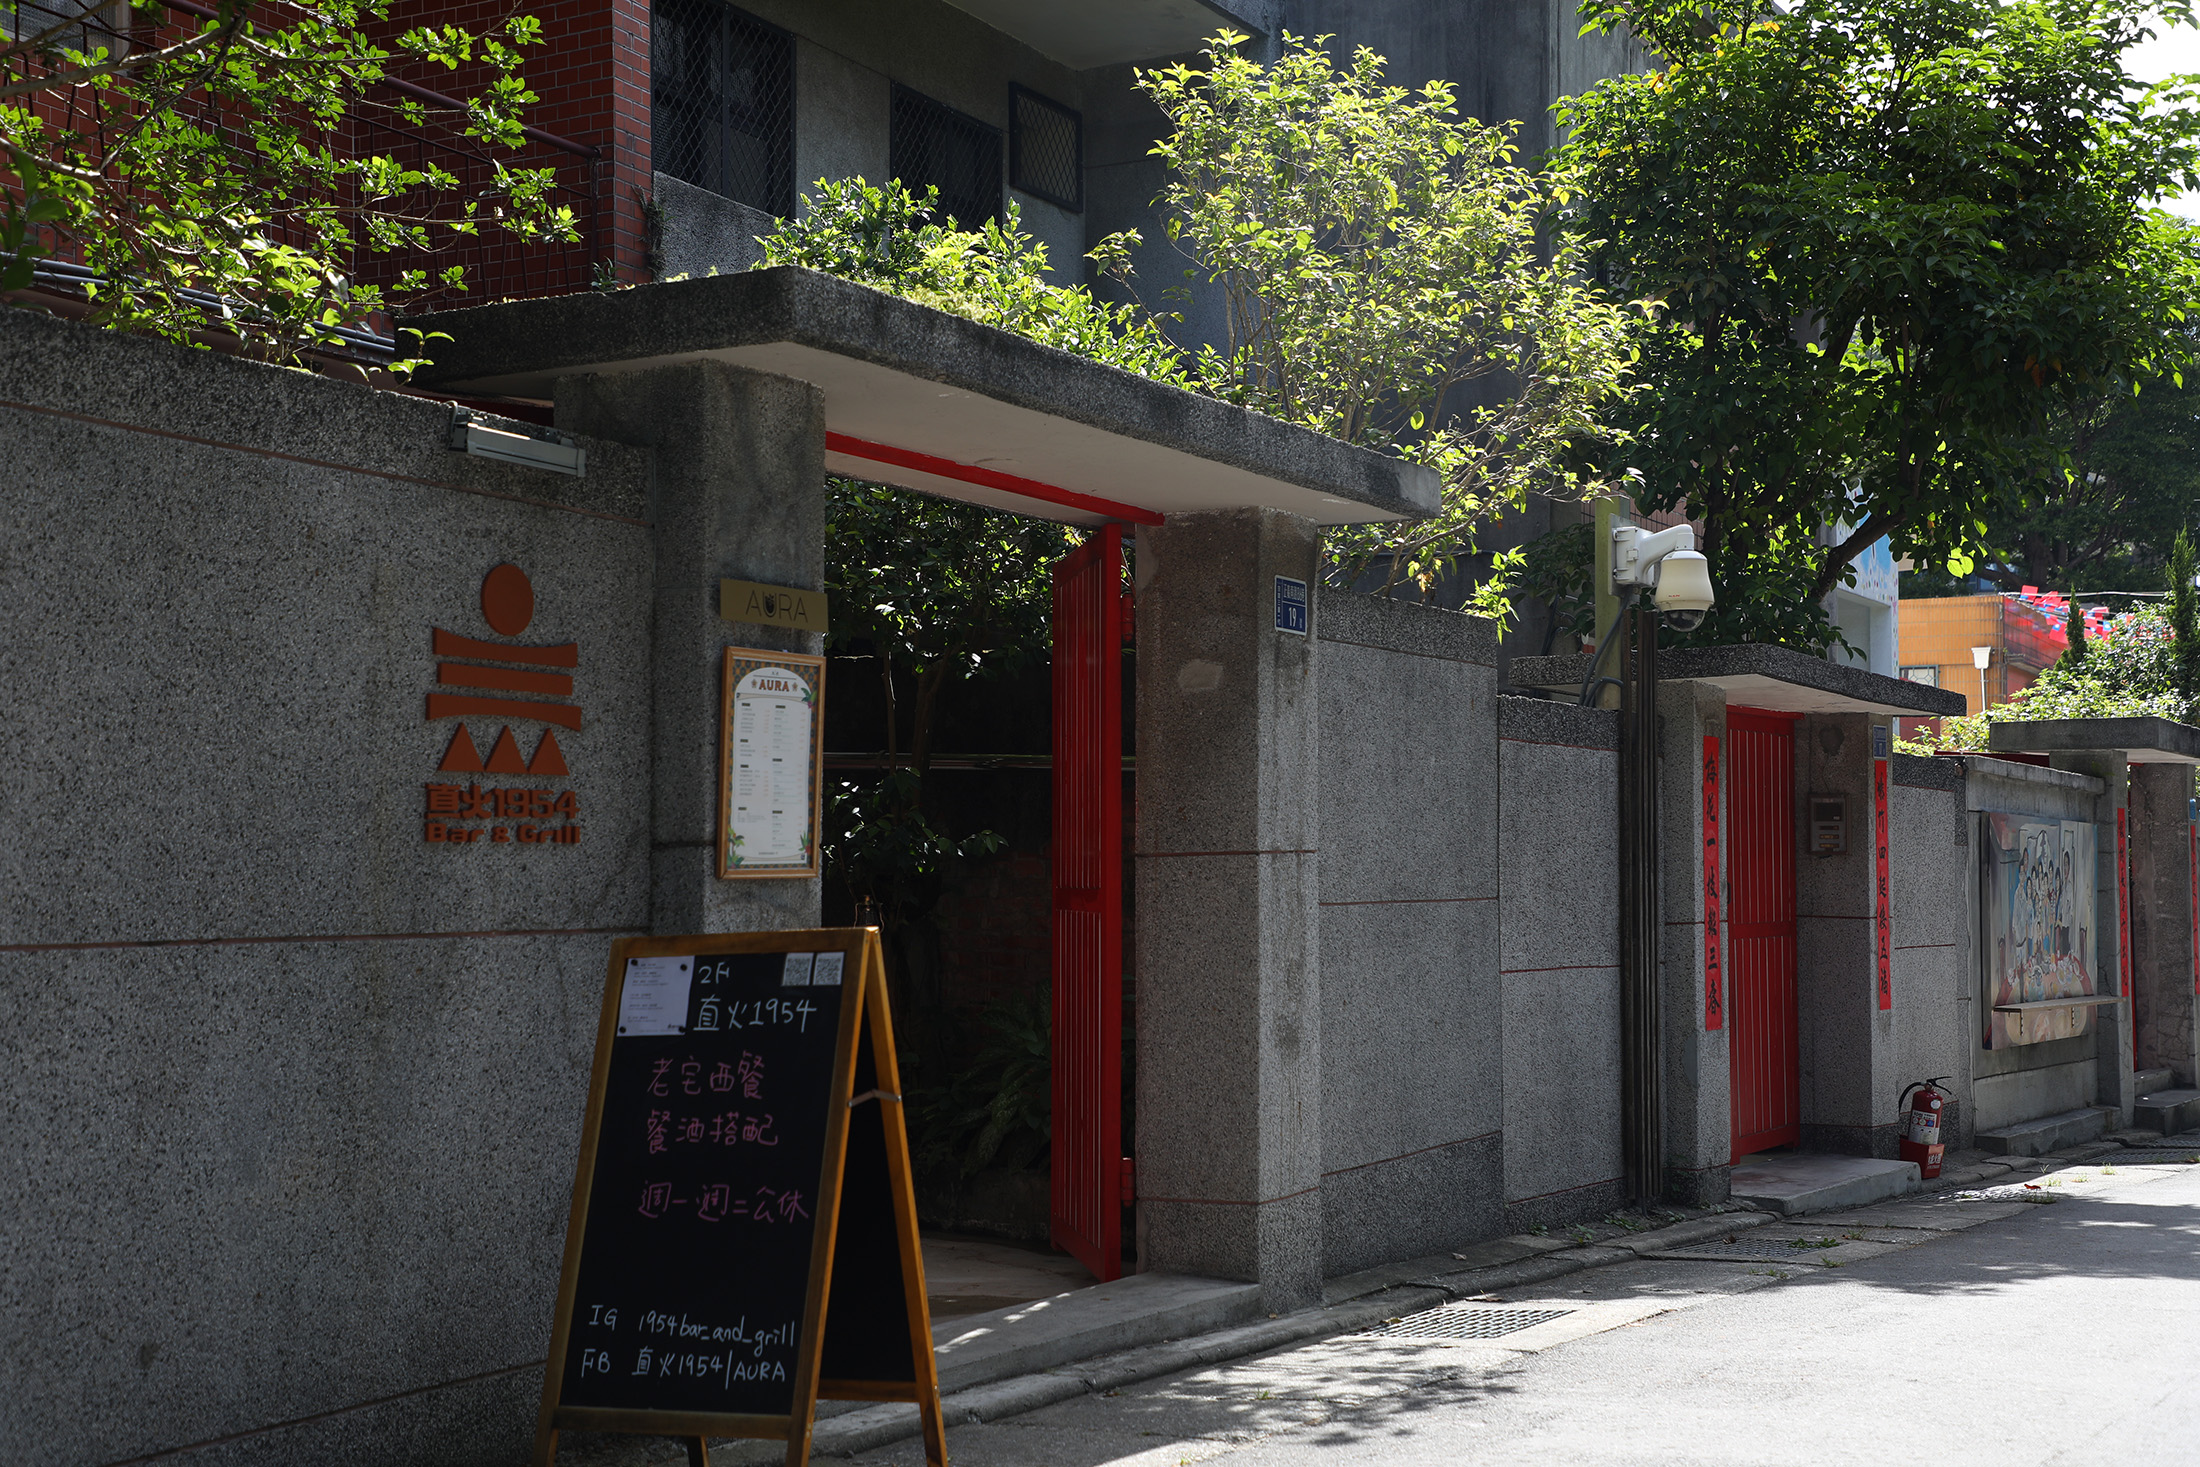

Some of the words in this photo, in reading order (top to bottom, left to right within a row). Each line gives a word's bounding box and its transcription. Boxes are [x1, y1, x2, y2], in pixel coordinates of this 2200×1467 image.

[745, 589, 808, 623] AURA
[1288, 607, 1297, 627] 19
[759, 679, 790, 692] AURA
[425, 783, 581, 820] 直火1954
[425, 822, 485, 843] Bar
[491, 826, 510, 843] &
[517, 824, 581, 844] Grill
[693, 994, 817, 1033] 直火1954
[647, 1051, 764, 1099] 老宅西餐
[647, 1109, 778, 1154] 餐酒搭配
[638, 1180, 808, 1223] 週一週二公休
[589, 1304, 618, 1331] IG
[581, 1348, 610, 1378] FB
